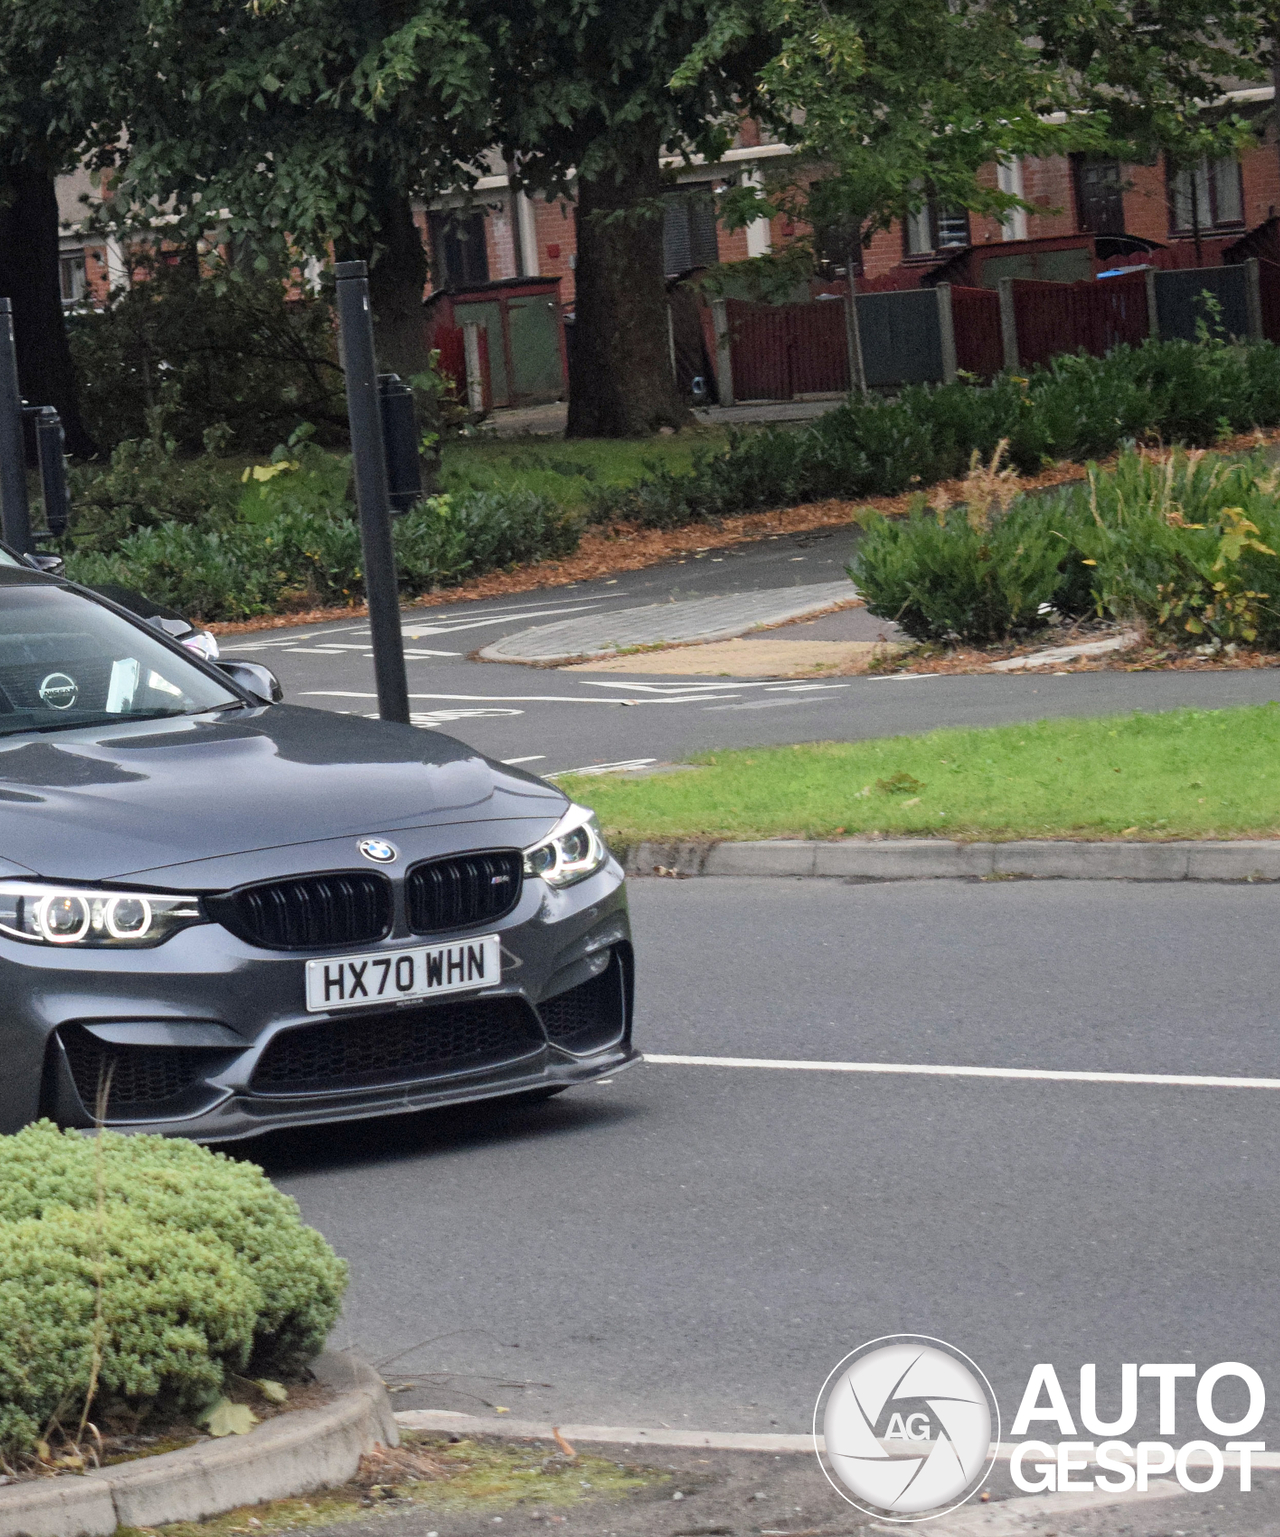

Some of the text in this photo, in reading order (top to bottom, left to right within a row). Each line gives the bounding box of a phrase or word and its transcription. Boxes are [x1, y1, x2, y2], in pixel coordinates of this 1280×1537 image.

[44, 687, 77, 697] NISSAN
[324, 943, 485, 1001] HX70 WHN
